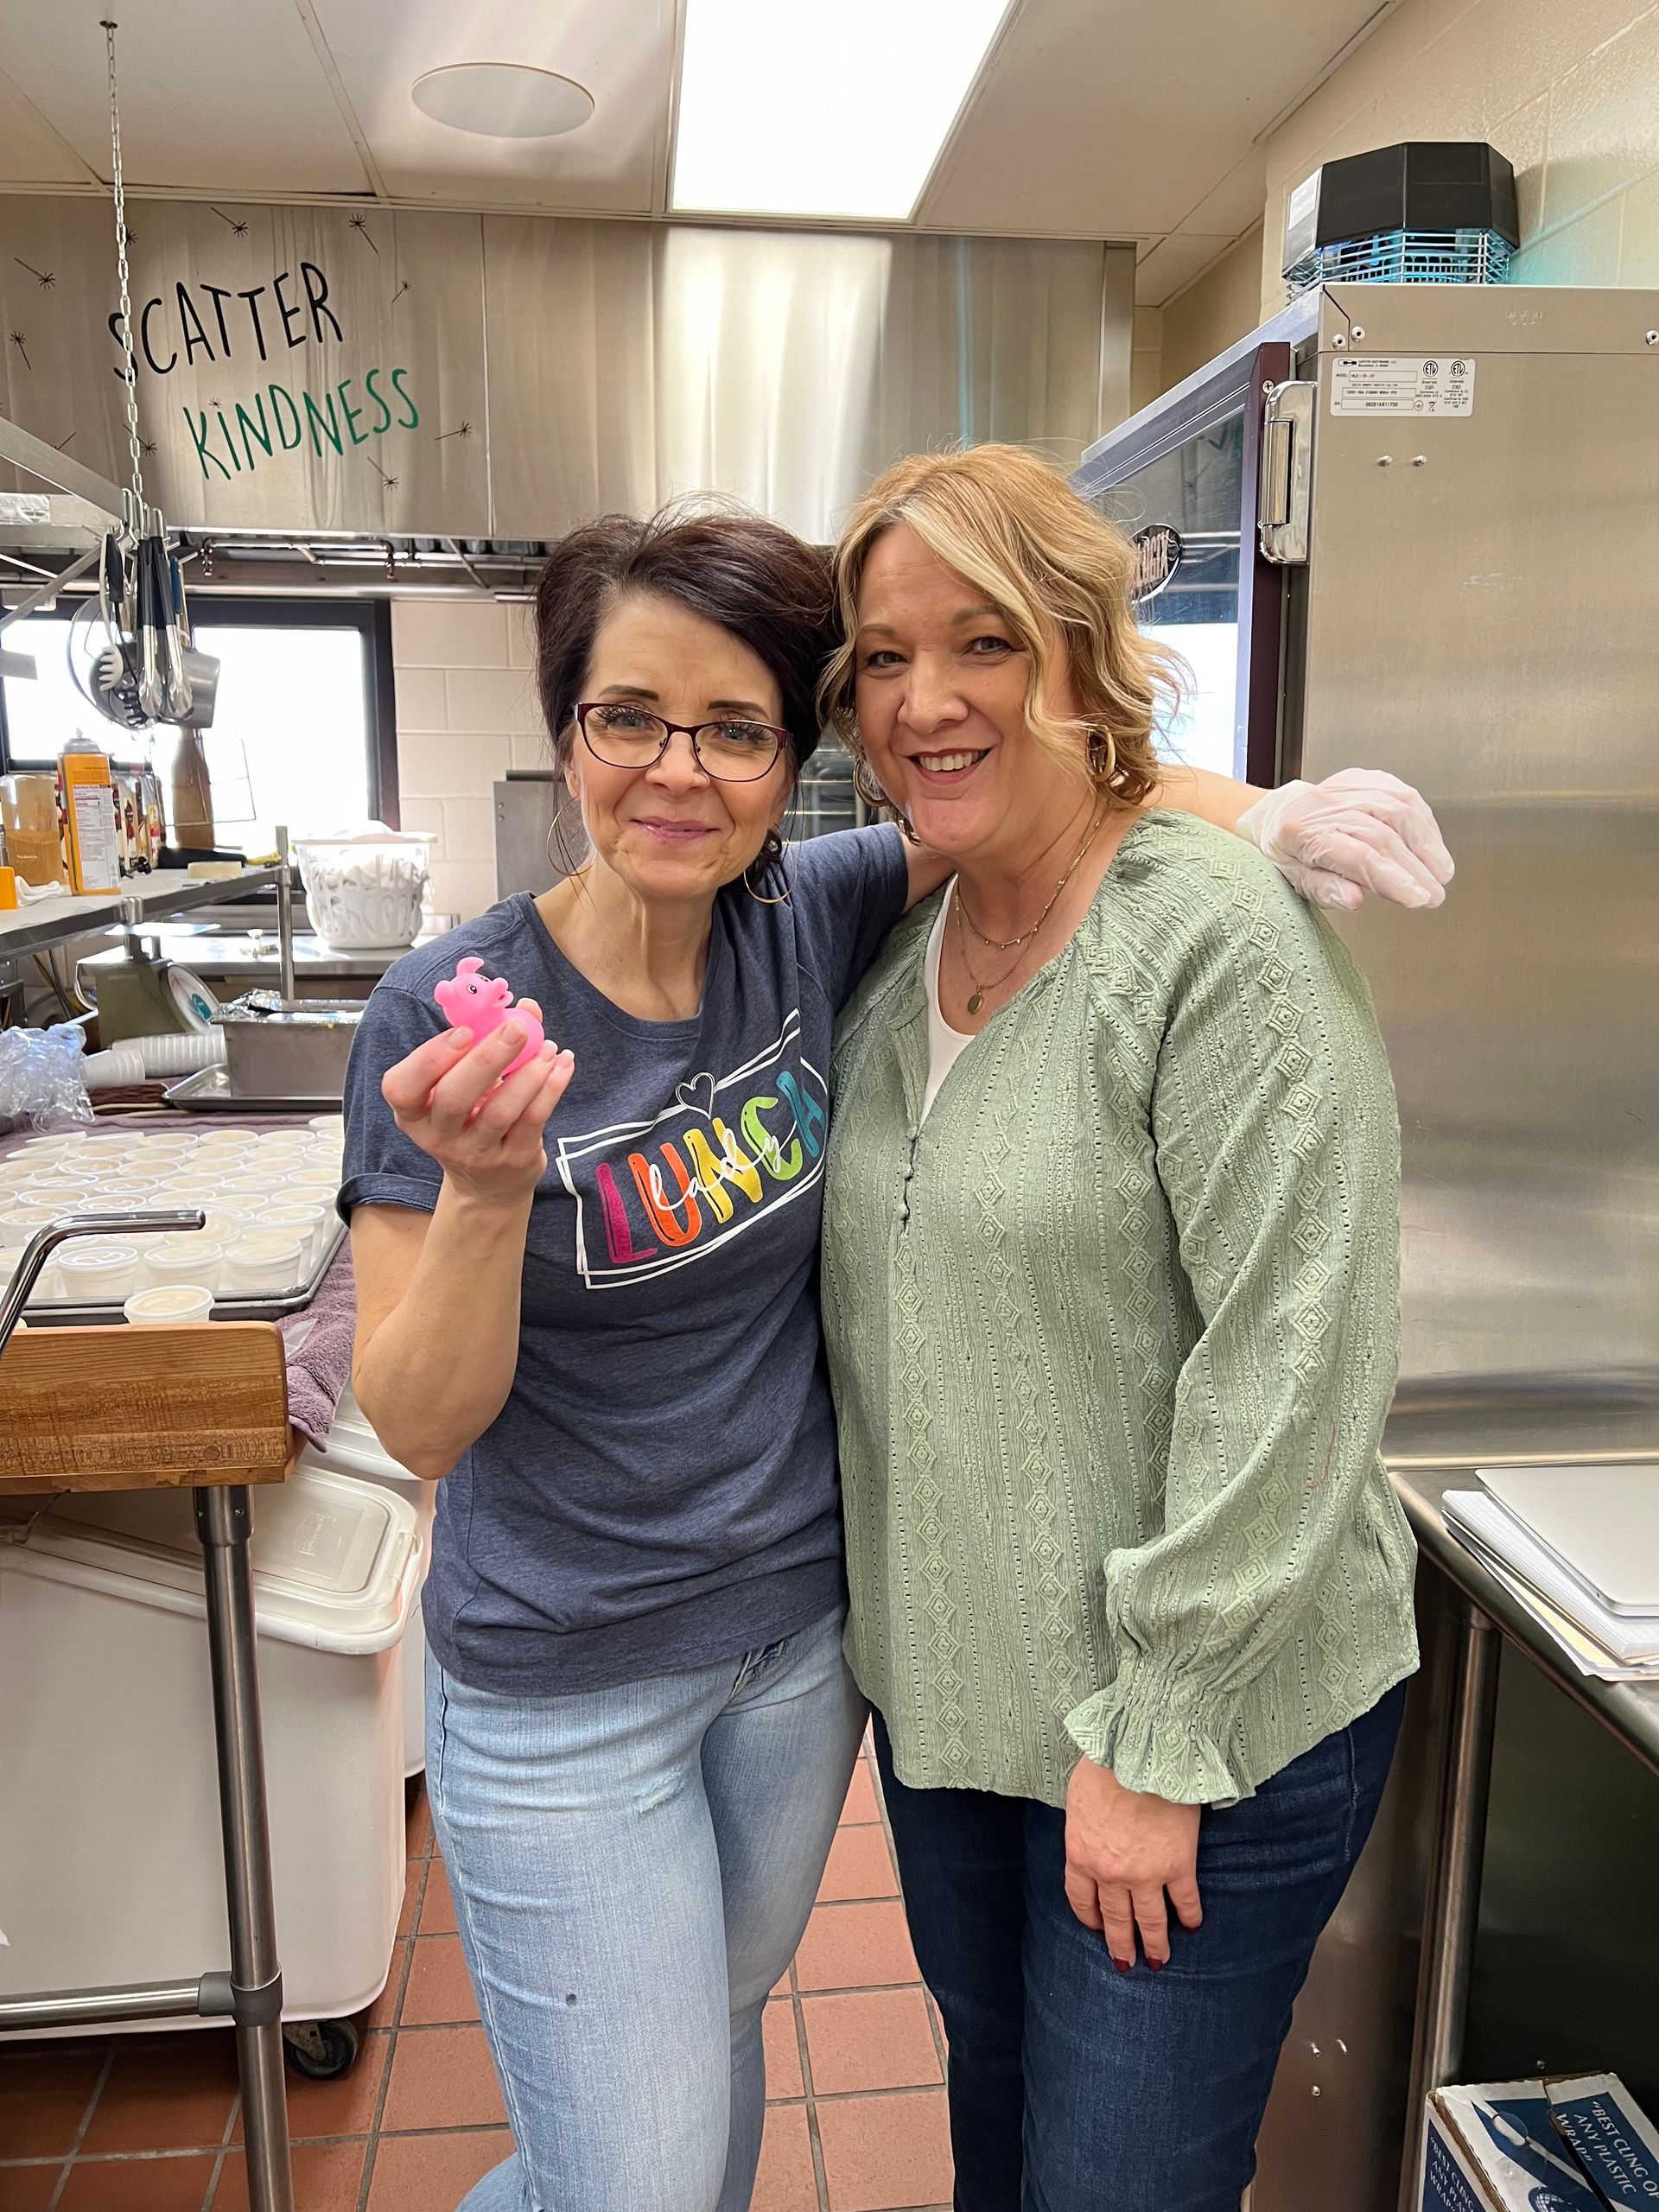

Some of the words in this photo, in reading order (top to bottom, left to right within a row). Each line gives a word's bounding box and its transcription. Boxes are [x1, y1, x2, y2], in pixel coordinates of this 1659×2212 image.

[108, 262, 344, 383] SCATTER
[182, 368, 420, 481] KINDNESS
[594, 1070, 827, 1264] LUNCH
[1573, 2113, 1602, 2141] ANY
[1593, 2145, 1637, 2195] PLASTIC
[1613, 2138, 1649, 2177] CLING
